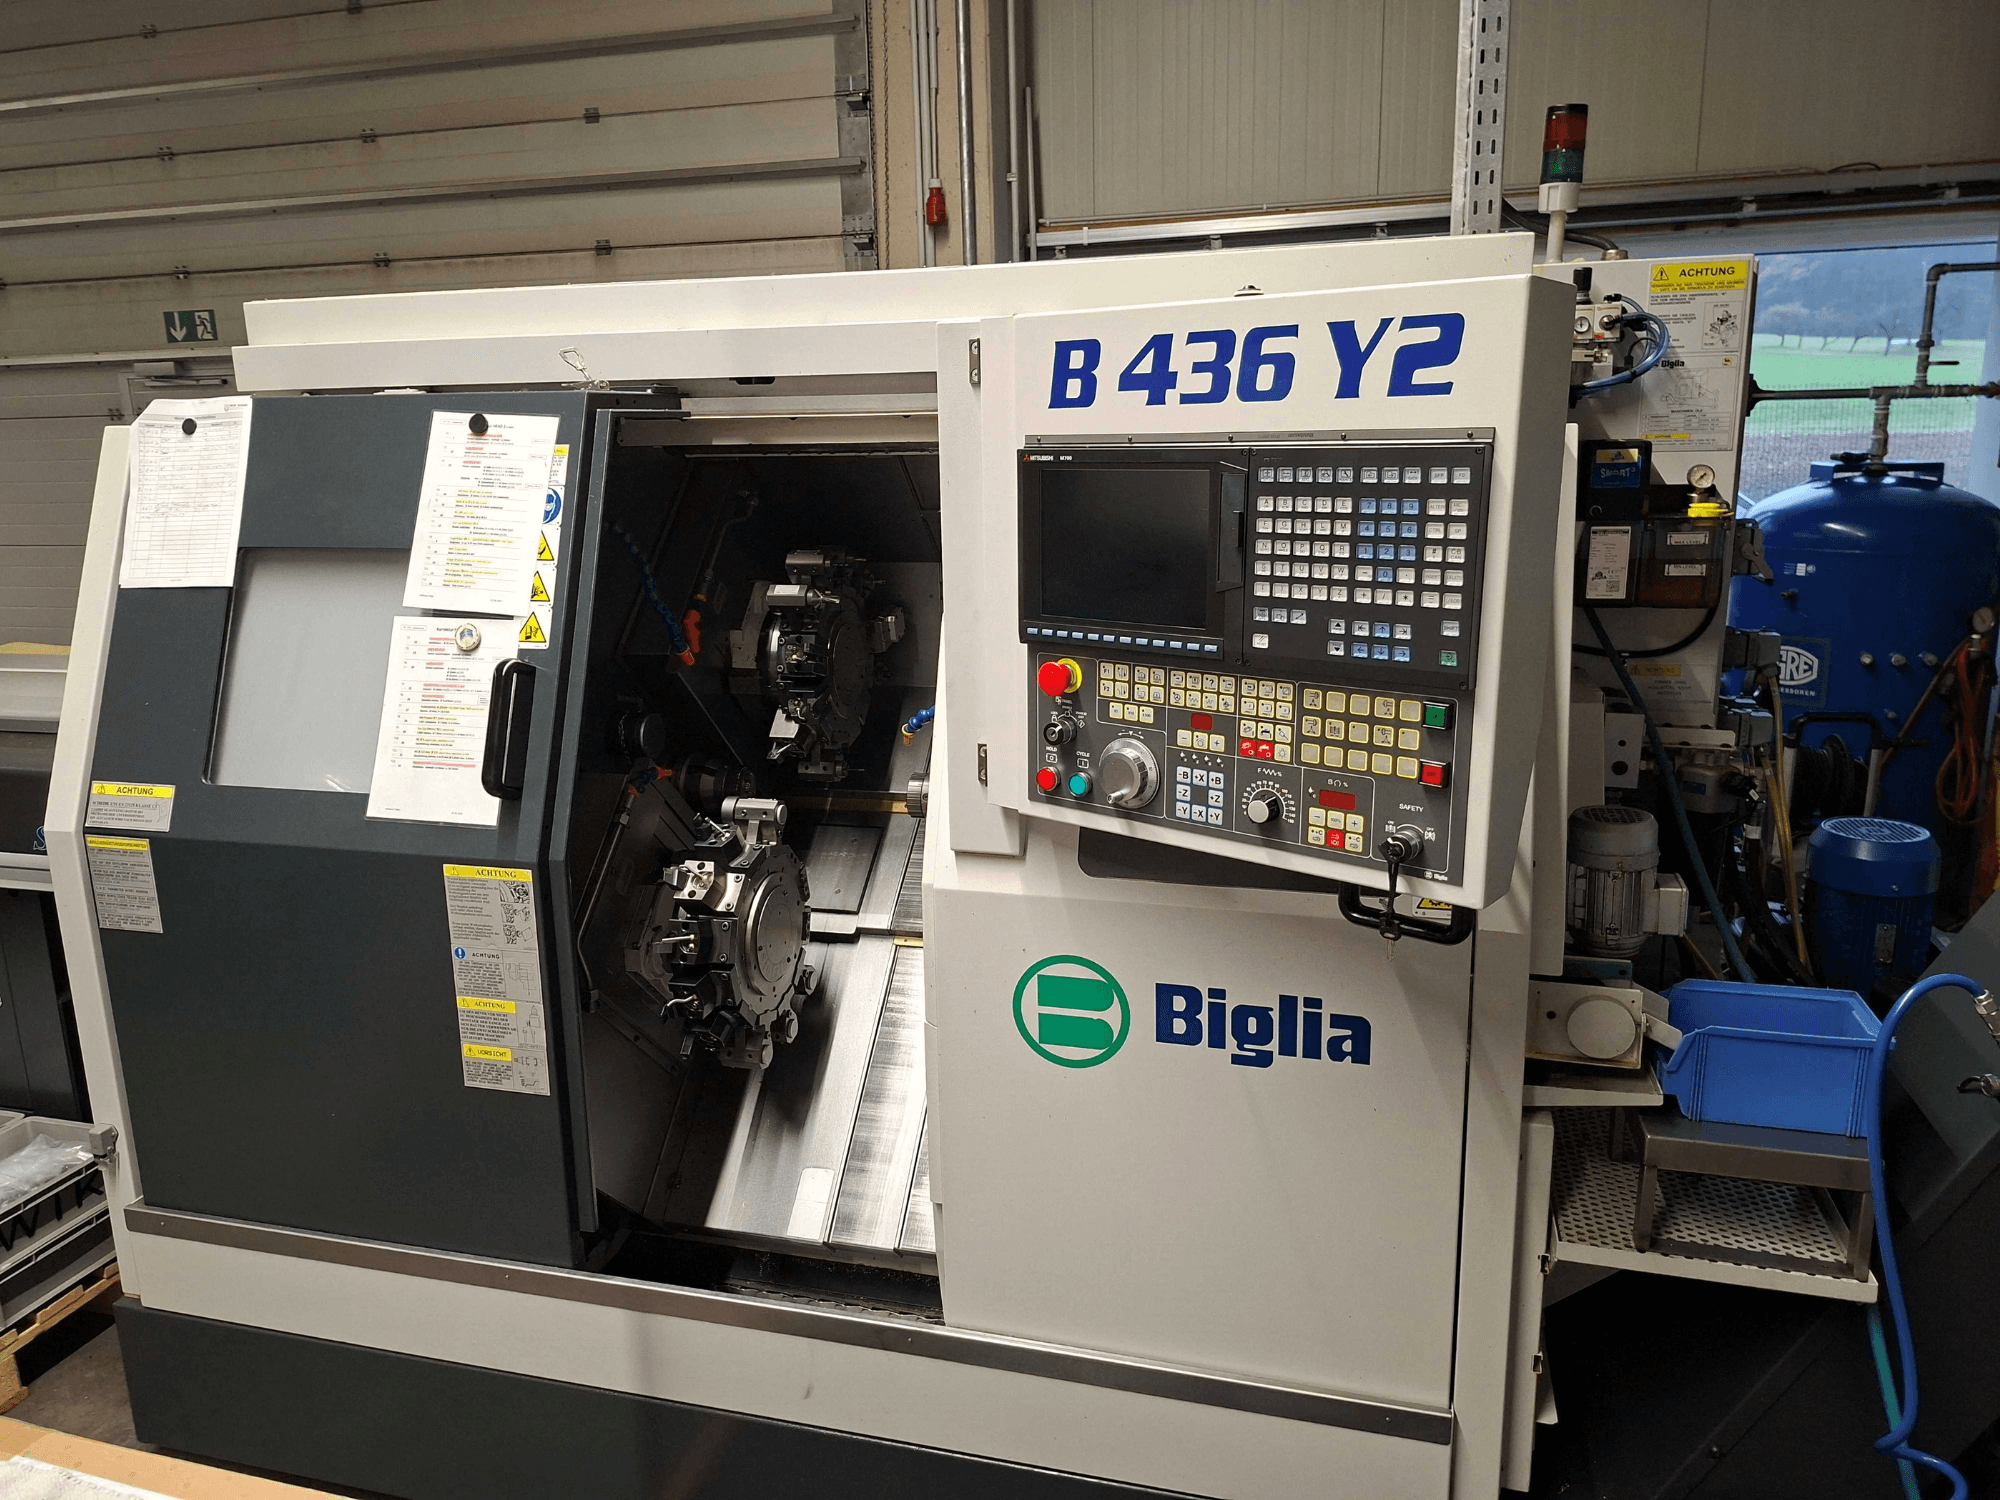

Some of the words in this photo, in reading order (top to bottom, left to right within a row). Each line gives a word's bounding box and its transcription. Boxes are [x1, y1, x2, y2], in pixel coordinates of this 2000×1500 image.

[1679, 266, 1735, 277] ACHTUNG
[1048, 337, 1101, 409] B
[1117, 324, 1300, 407] 436
[1325, 312, 1466, 399] Y2
[116, 786, 154, 796] ACHTUNG
[1399, 803, 1424, 812] SAFETY
[475, 870, 516, 878] ACHTUNG
[1155, 982, 1372, 1068] Biglia
[478, 1049, 507, 1057] VORSICHT
